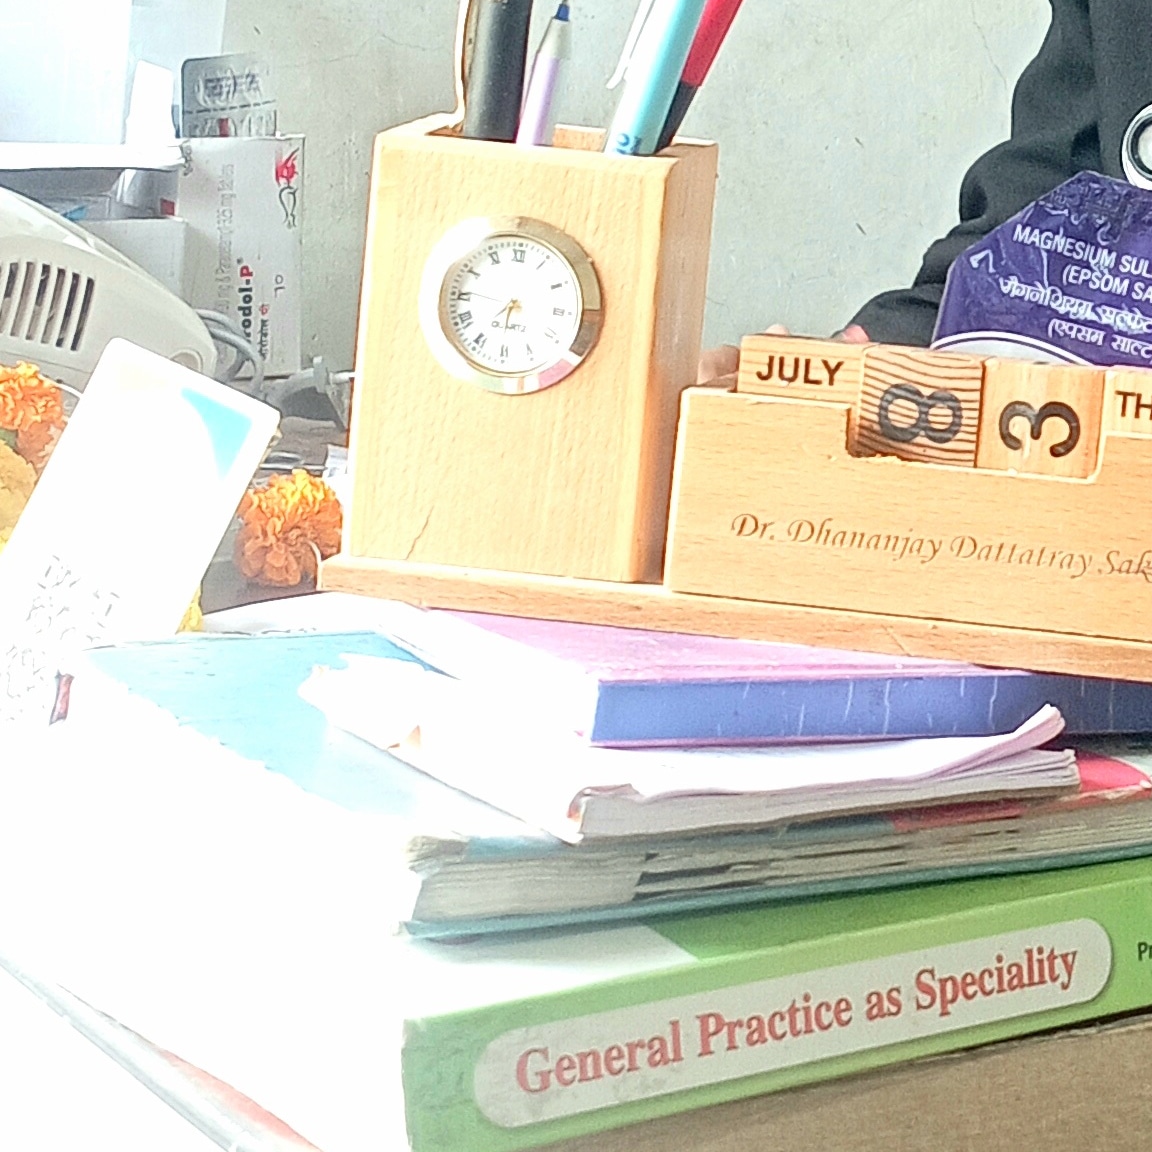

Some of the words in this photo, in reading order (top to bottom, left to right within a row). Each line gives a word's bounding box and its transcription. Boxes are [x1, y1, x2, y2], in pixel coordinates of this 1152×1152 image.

[1013, 223, 1118, 270] MAGNESIUM
[1062, 263, 1129, 296] (EPSOM
[755, 354, 845, 387] JULY
[876, 382, 964, 444] 8
[999, 399, 1081, 459] 3
[731, 513, 777, 542] Dr.
[786, 516, 943, 564] Dhananjay
[949, 535, 1094, 578] Dattatray
[515, 1020, 683, 1095] General
[697, 992, 854, 1058] Practice
[864, 984, 903, 1020] as
[914, 945, 1079, 1016] Speciality
